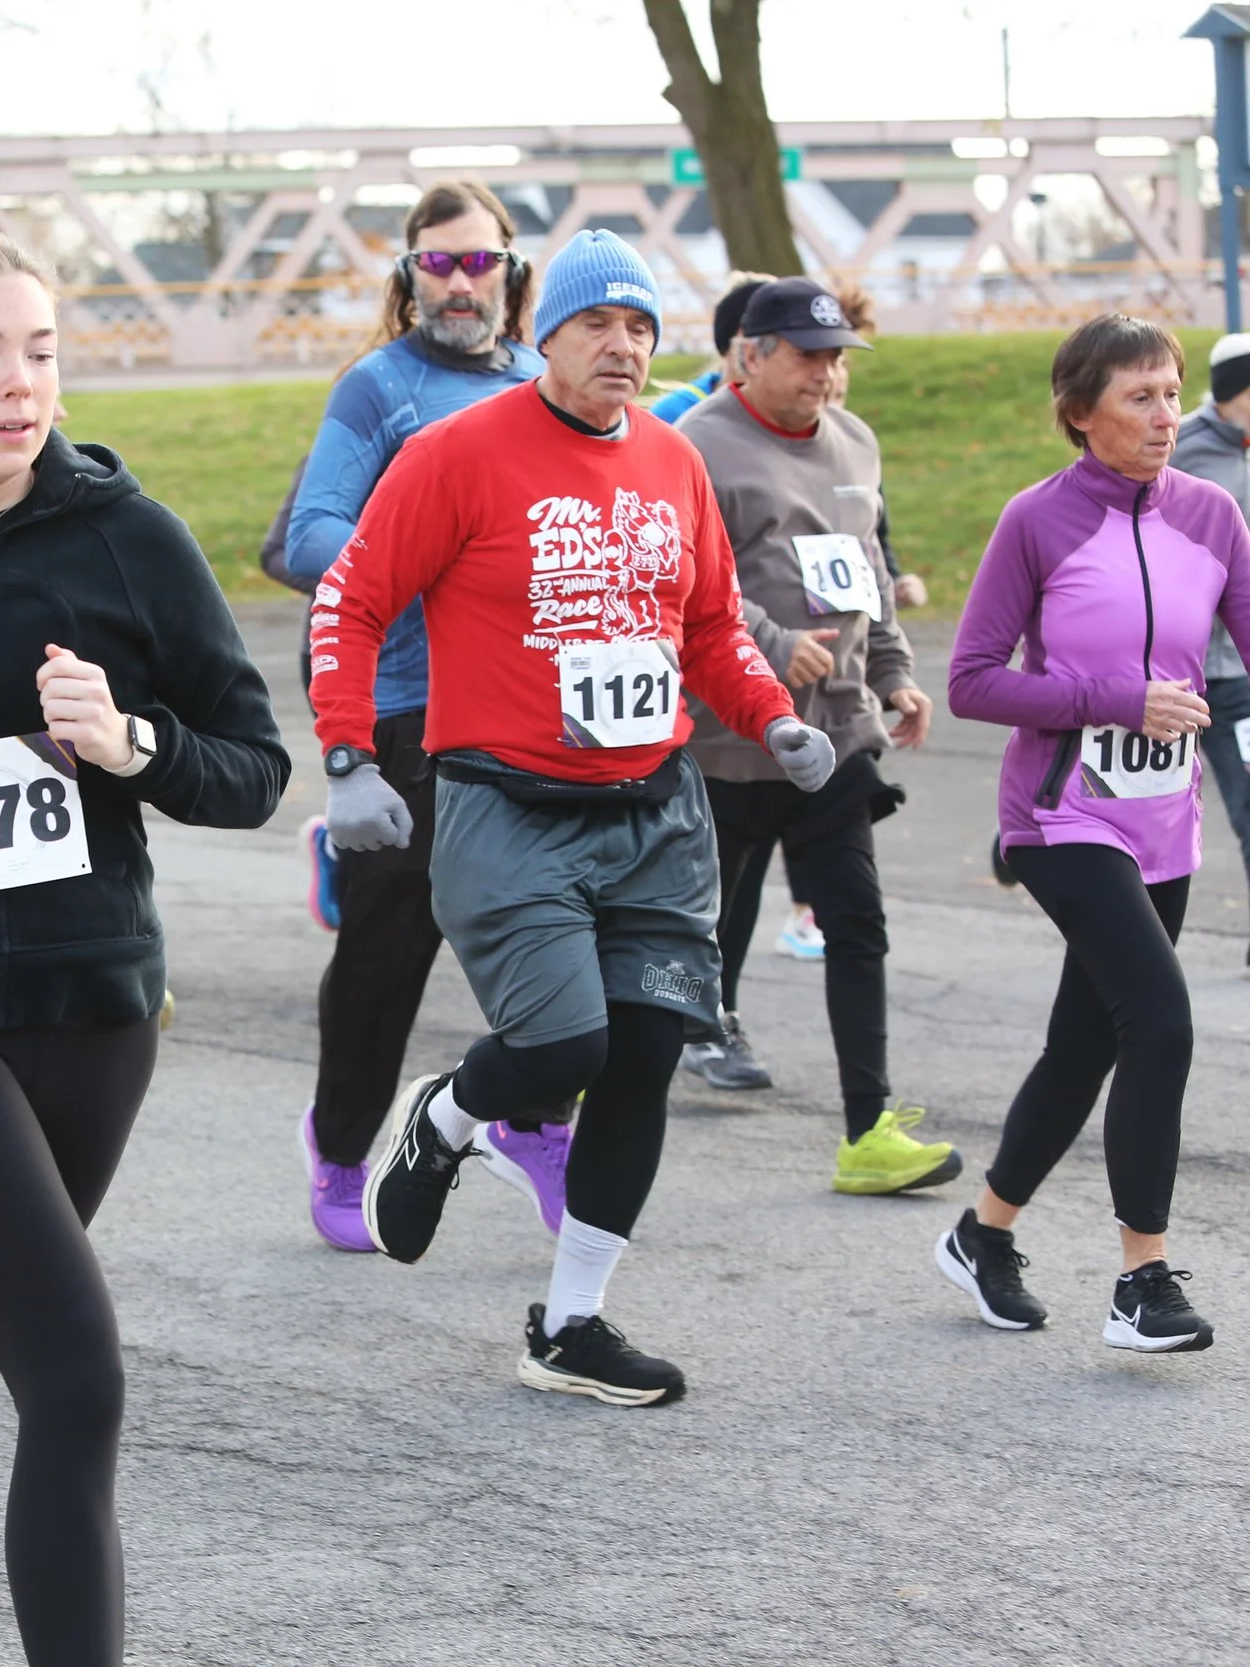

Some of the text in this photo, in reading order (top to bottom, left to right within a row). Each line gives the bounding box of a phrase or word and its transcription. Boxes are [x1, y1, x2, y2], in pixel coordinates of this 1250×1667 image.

[527, 496, 602, 531] Mr.
[529, 522, 603, 572] ED'S
[557, 575, 610, 597] ANNUAL
[530, 595, 604, 626] Race
[573, 670, 669, 721] 1121
[1093, 729, 1188, 773] 1081
[641, 963, 704, 1003] OHIO
